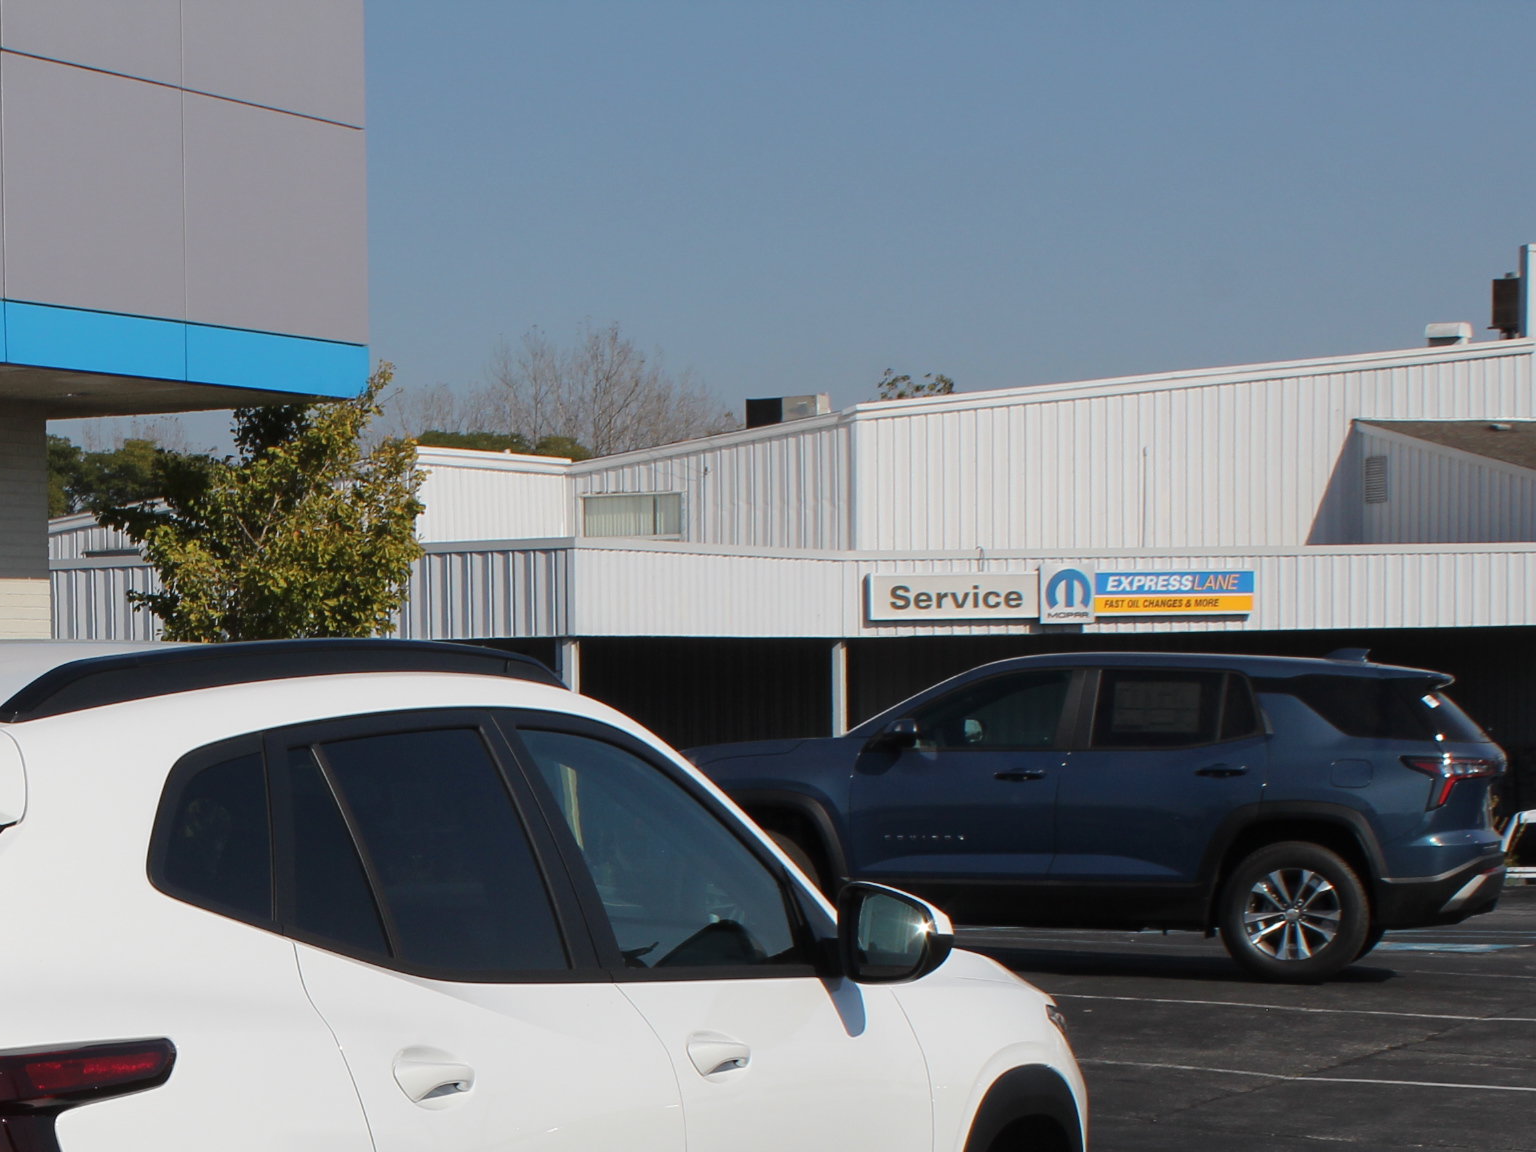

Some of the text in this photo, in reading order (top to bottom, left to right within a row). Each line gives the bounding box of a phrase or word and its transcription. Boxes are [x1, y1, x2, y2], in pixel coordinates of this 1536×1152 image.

[1105, 574, 1241, 592] EXPRESSLANE
[889, 584, 1024, 611] Service
[1104, 598, 1220, 608] FAST OIL CHANGES & MORE
